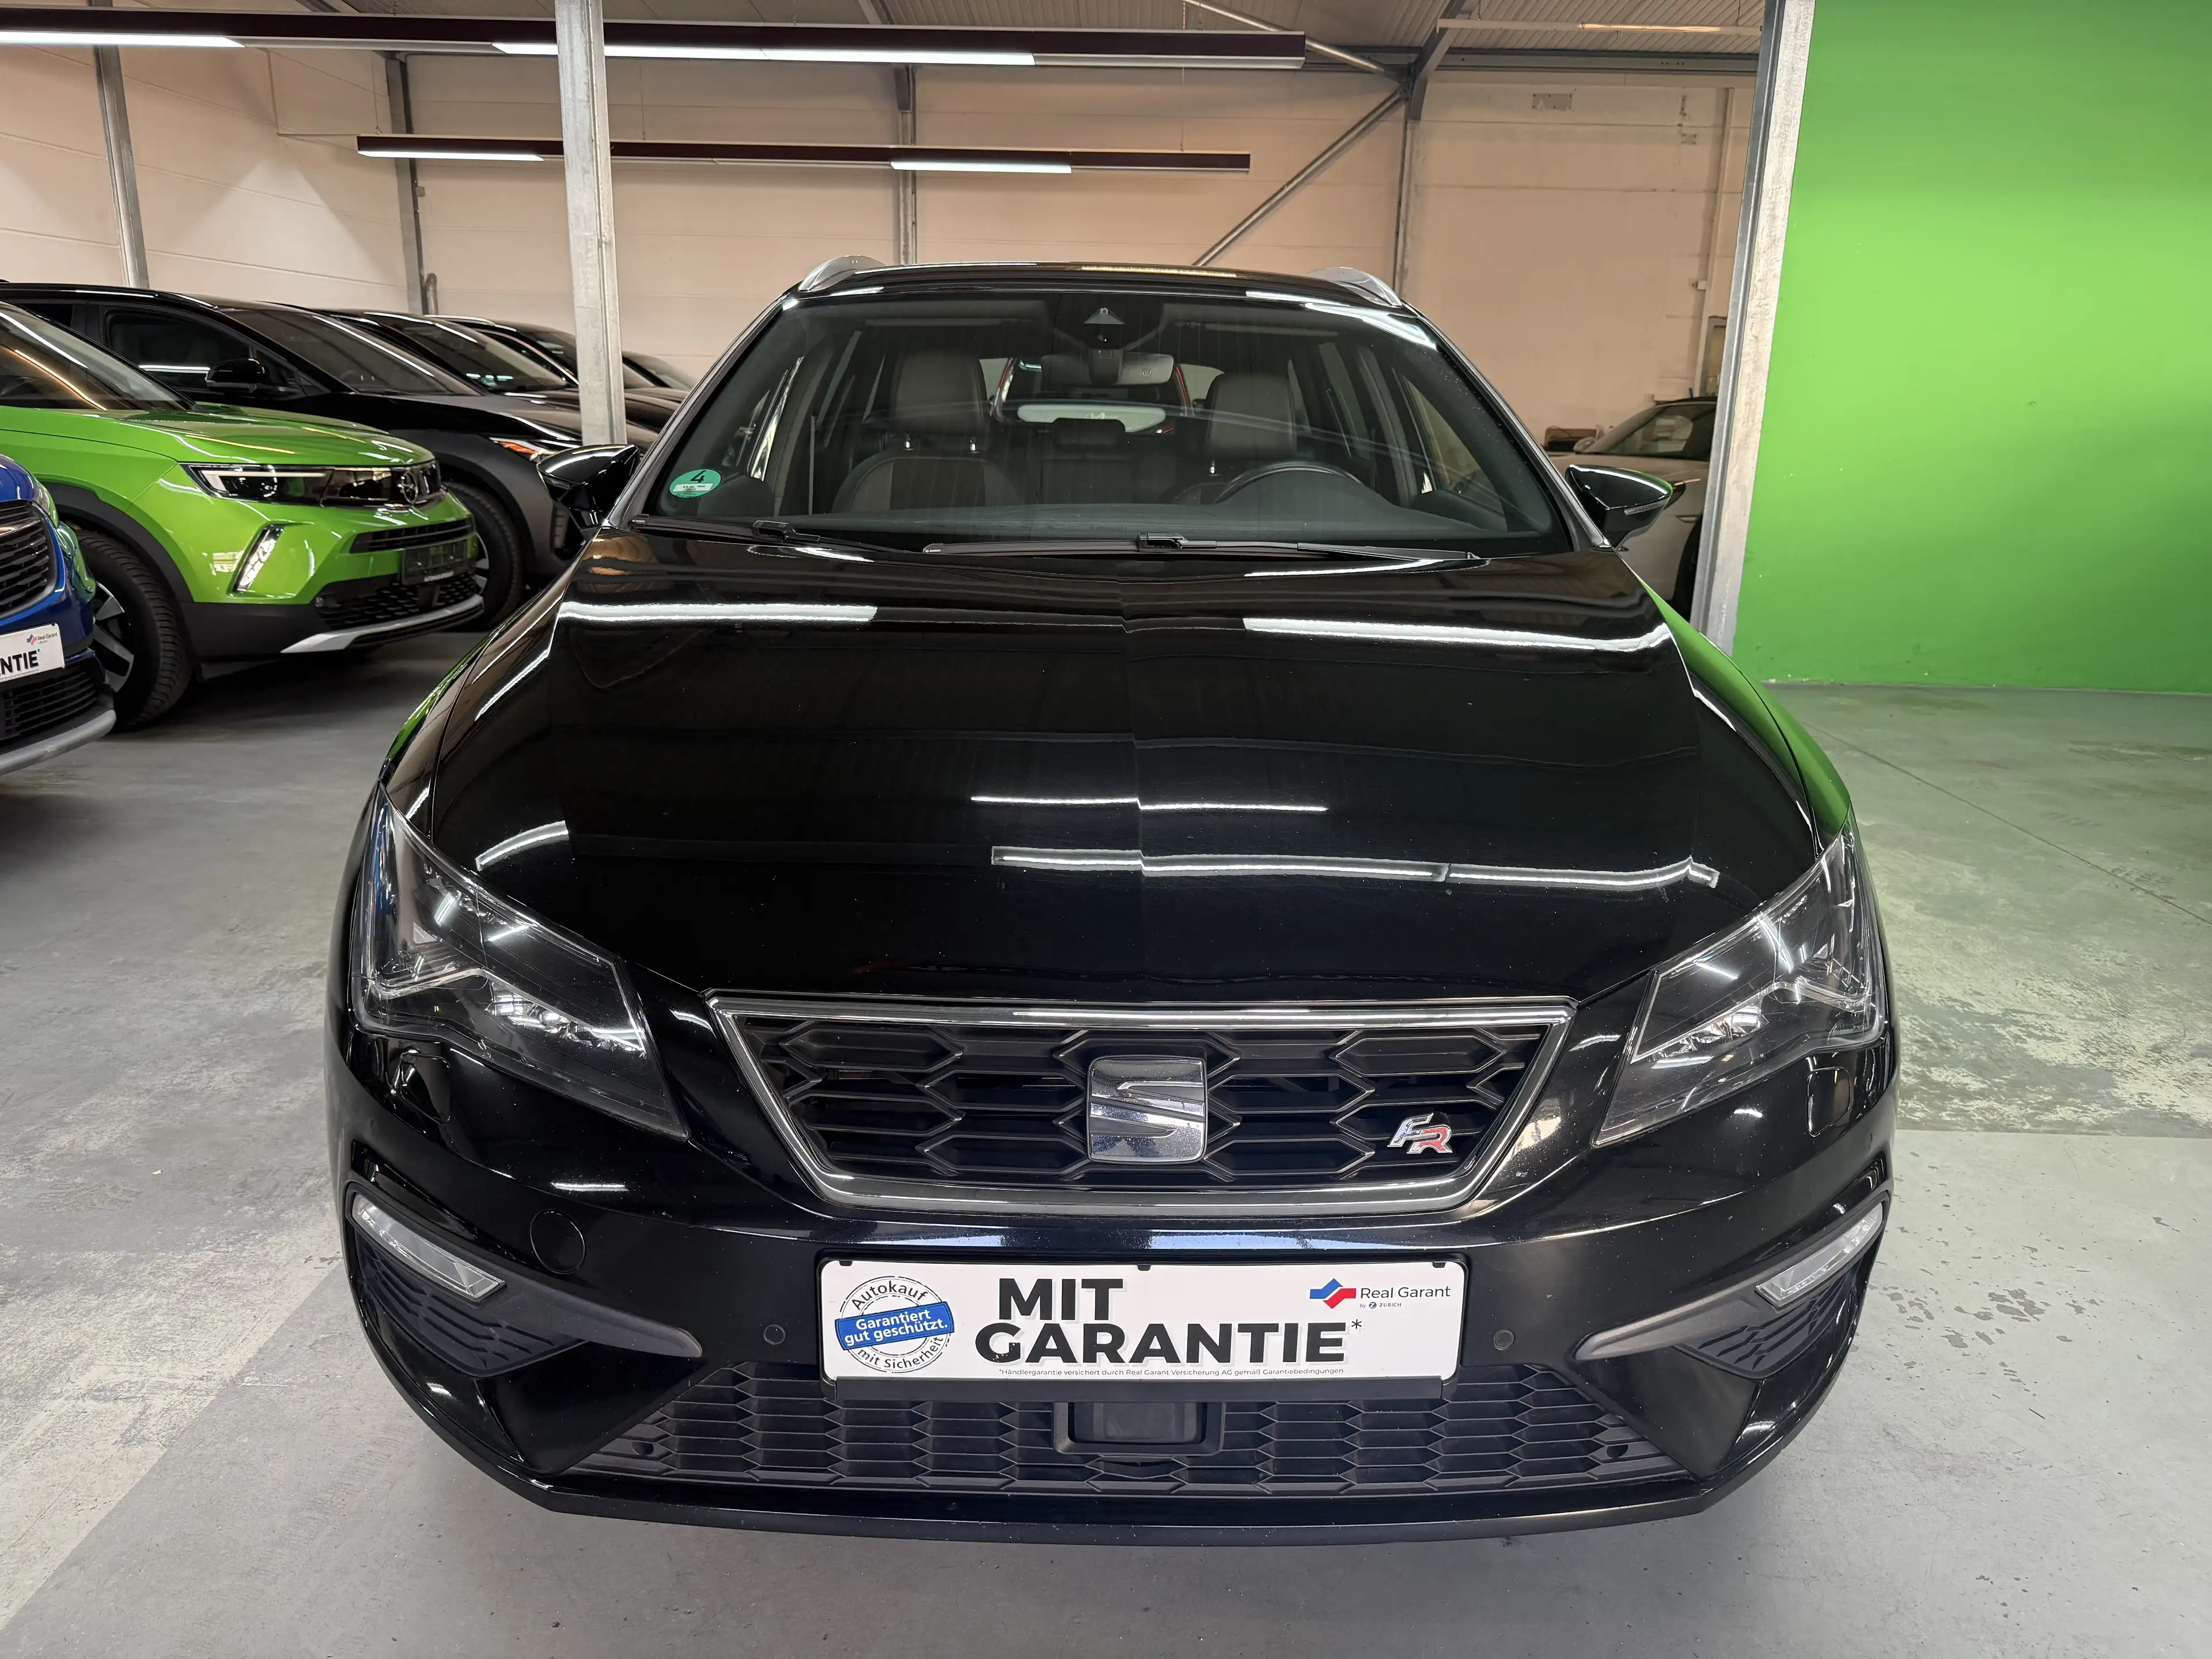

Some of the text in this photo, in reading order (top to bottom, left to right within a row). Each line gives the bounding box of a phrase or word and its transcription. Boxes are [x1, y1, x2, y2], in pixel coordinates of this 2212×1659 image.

[690, 470, 707, 483] 4
[0, 649, 40, 675] NTIE
[1387, 1112, 1452, 1154] FR
[851, 1280, 929, 1310] Autokauf
[999, 1278, 1123, 1320] MIT
[1360, 1286, 1451, 1298] Real Garant
[844, 1318, 948, 1346] gut geschützt.
[855, 1309, 931, 1330] Garantiert
[858, 1336, 944, 1369] mit Sicherheit
